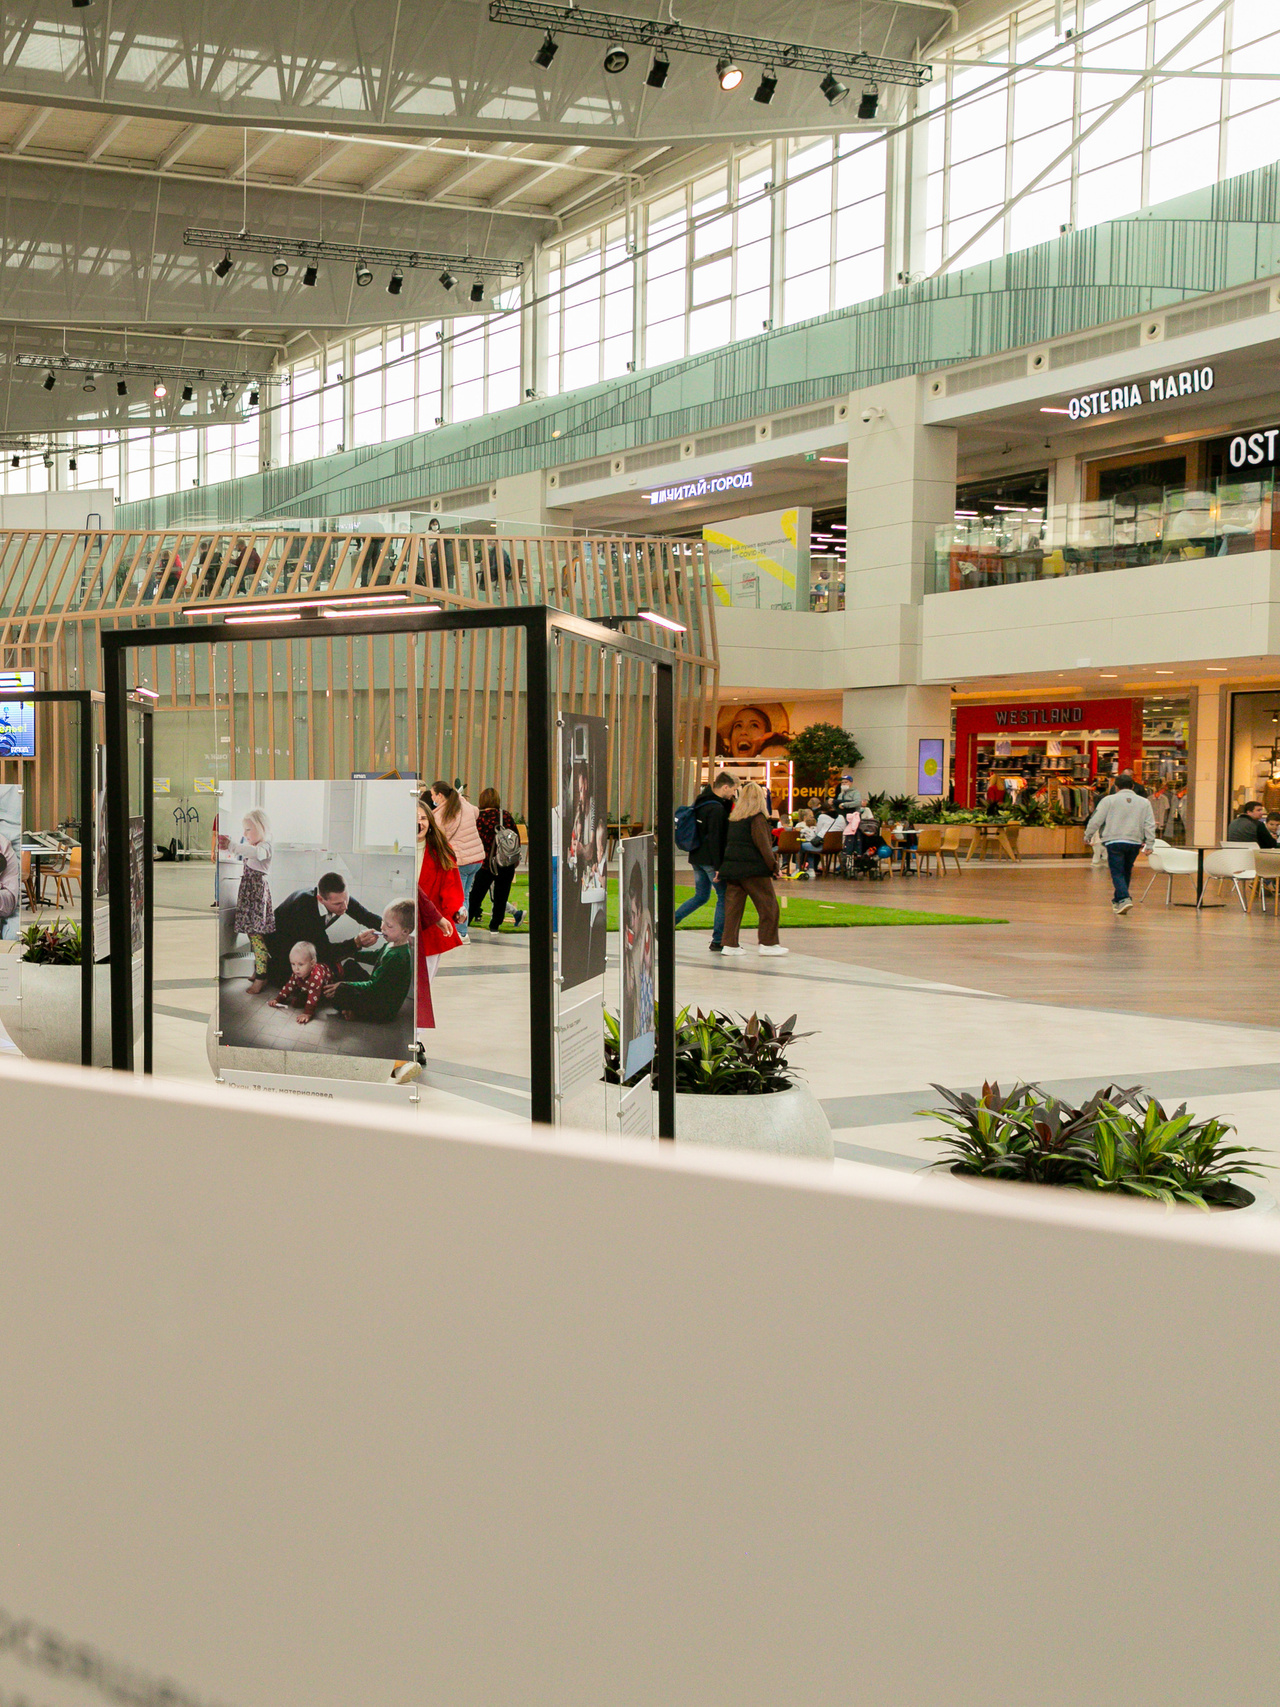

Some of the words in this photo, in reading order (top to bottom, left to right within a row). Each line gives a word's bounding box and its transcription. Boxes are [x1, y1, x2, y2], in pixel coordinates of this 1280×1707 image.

[1068, 384, 1142, 420] OSTERIA
[1149, 366, 1215, 403] MARIO
[1229, 429, 1280, 468] OST
[995, 707, 1083, 725] WESTLAND
[228, 1083, 251, 1091] Юхан,
[262, 1086, 276, 1094] лет,
[279, 1088, 333, 1099] материаловед
